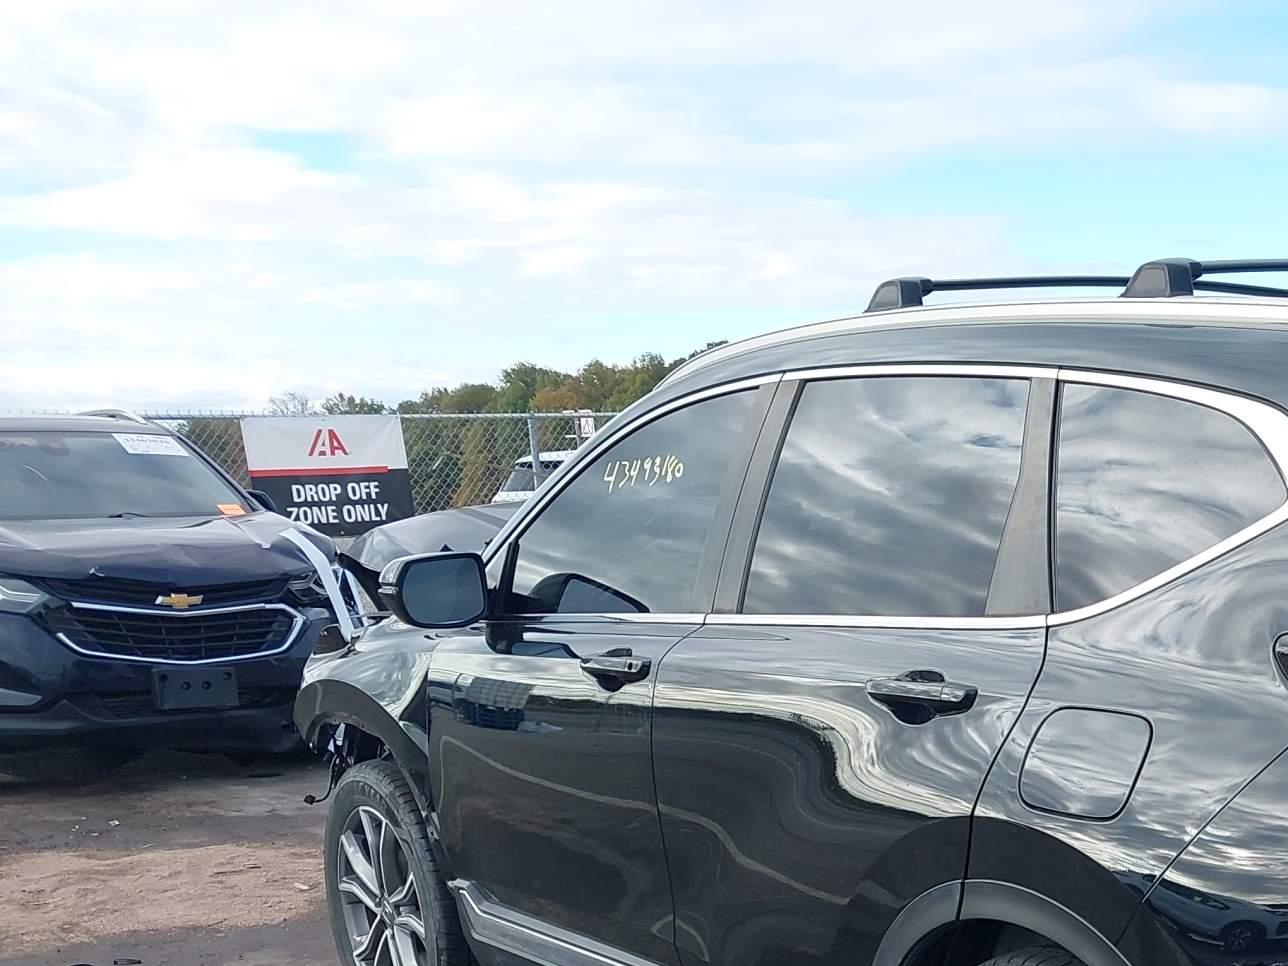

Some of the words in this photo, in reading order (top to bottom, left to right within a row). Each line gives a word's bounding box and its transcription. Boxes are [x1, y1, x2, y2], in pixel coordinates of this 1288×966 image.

[603, 453, 684, 494] 43493180
[291, 483, 342, 503] DROP
[347, 481, 381, 501] OFF
[286, 505, 340, 525] ZONE
[343, 503, 389, 523] ONLY
